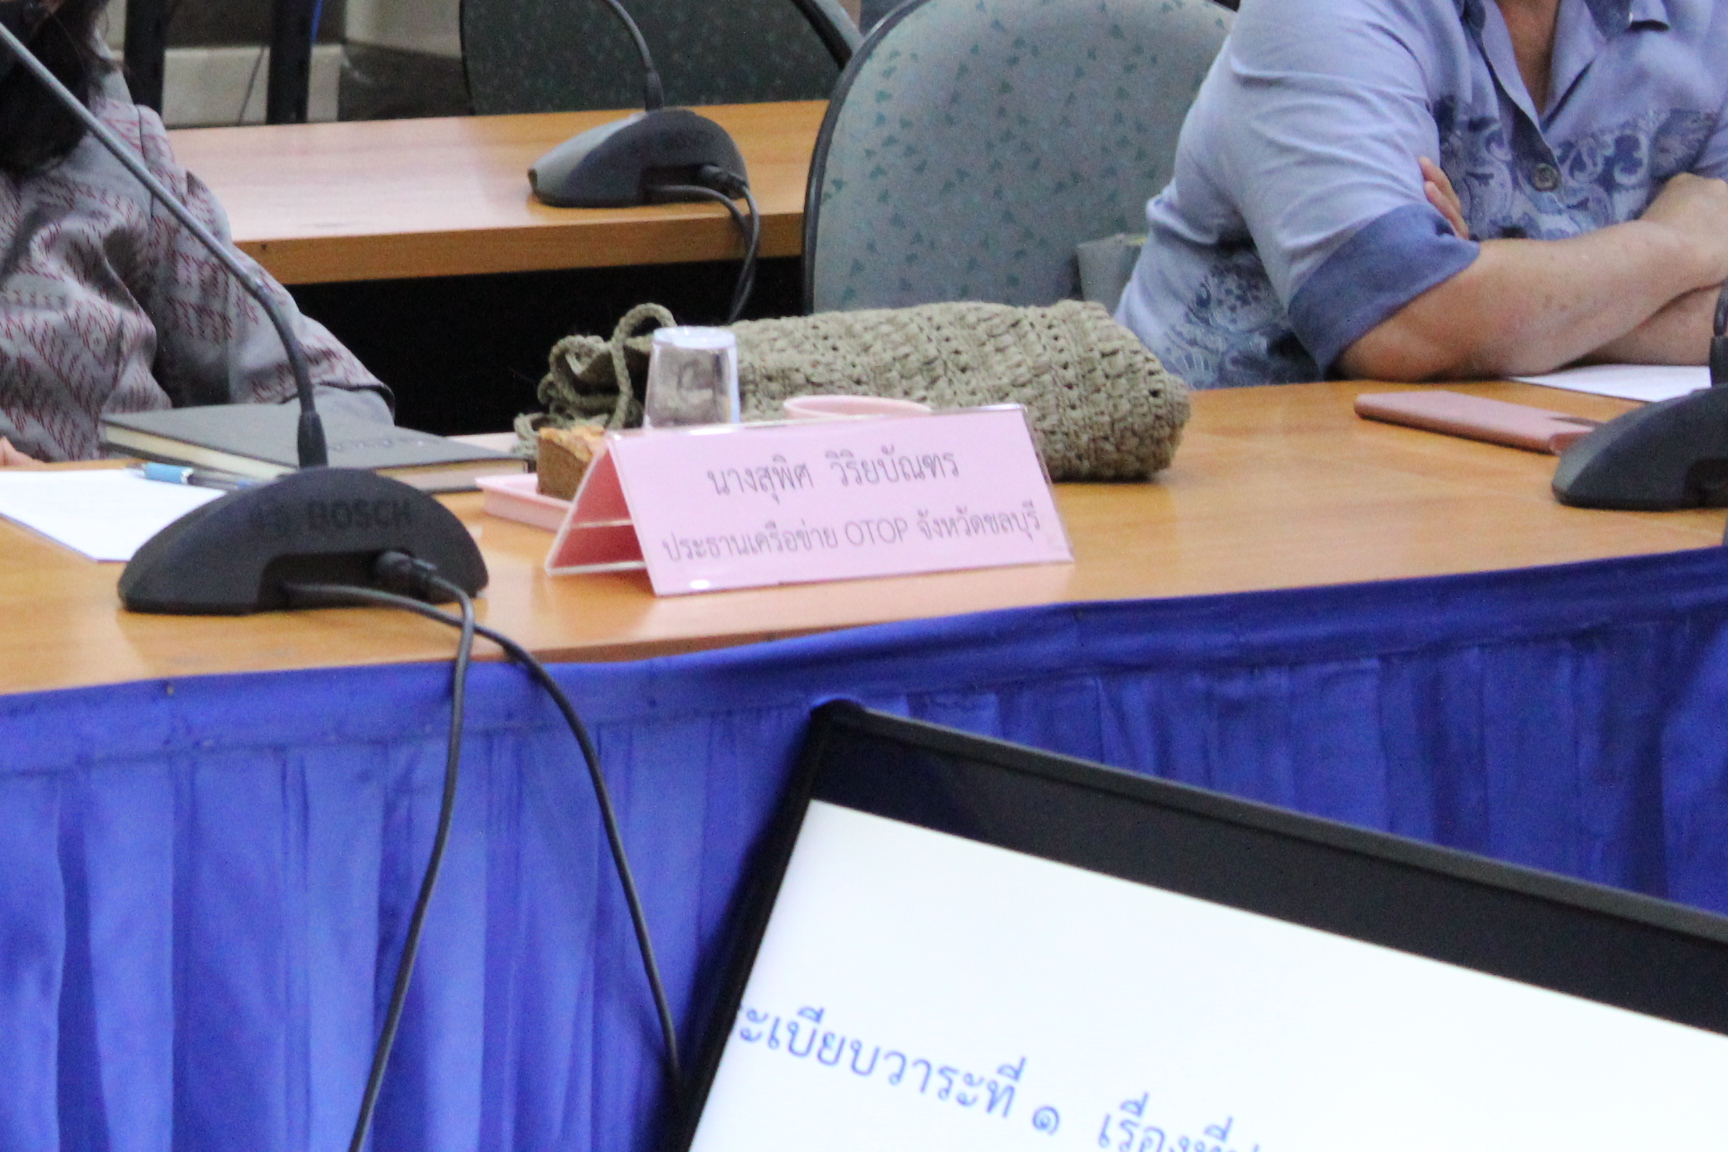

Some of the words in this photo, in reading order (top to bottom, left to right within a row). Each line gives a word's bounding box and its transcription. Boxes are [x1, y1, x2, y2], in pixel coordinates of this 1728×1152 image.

[707, 452, 814, 505] นางสุพิศ
[661, 518, 839, 563] ประธานเครือข่าย
[843, 515, 909, 548] OTOP
[916, 499, 1042, 543] จังหวัดชลบุรี
[737, 1004, 1027, 1120] ะเบียบวาระที่
[1031, 1102, 1062, 1136] ๑
